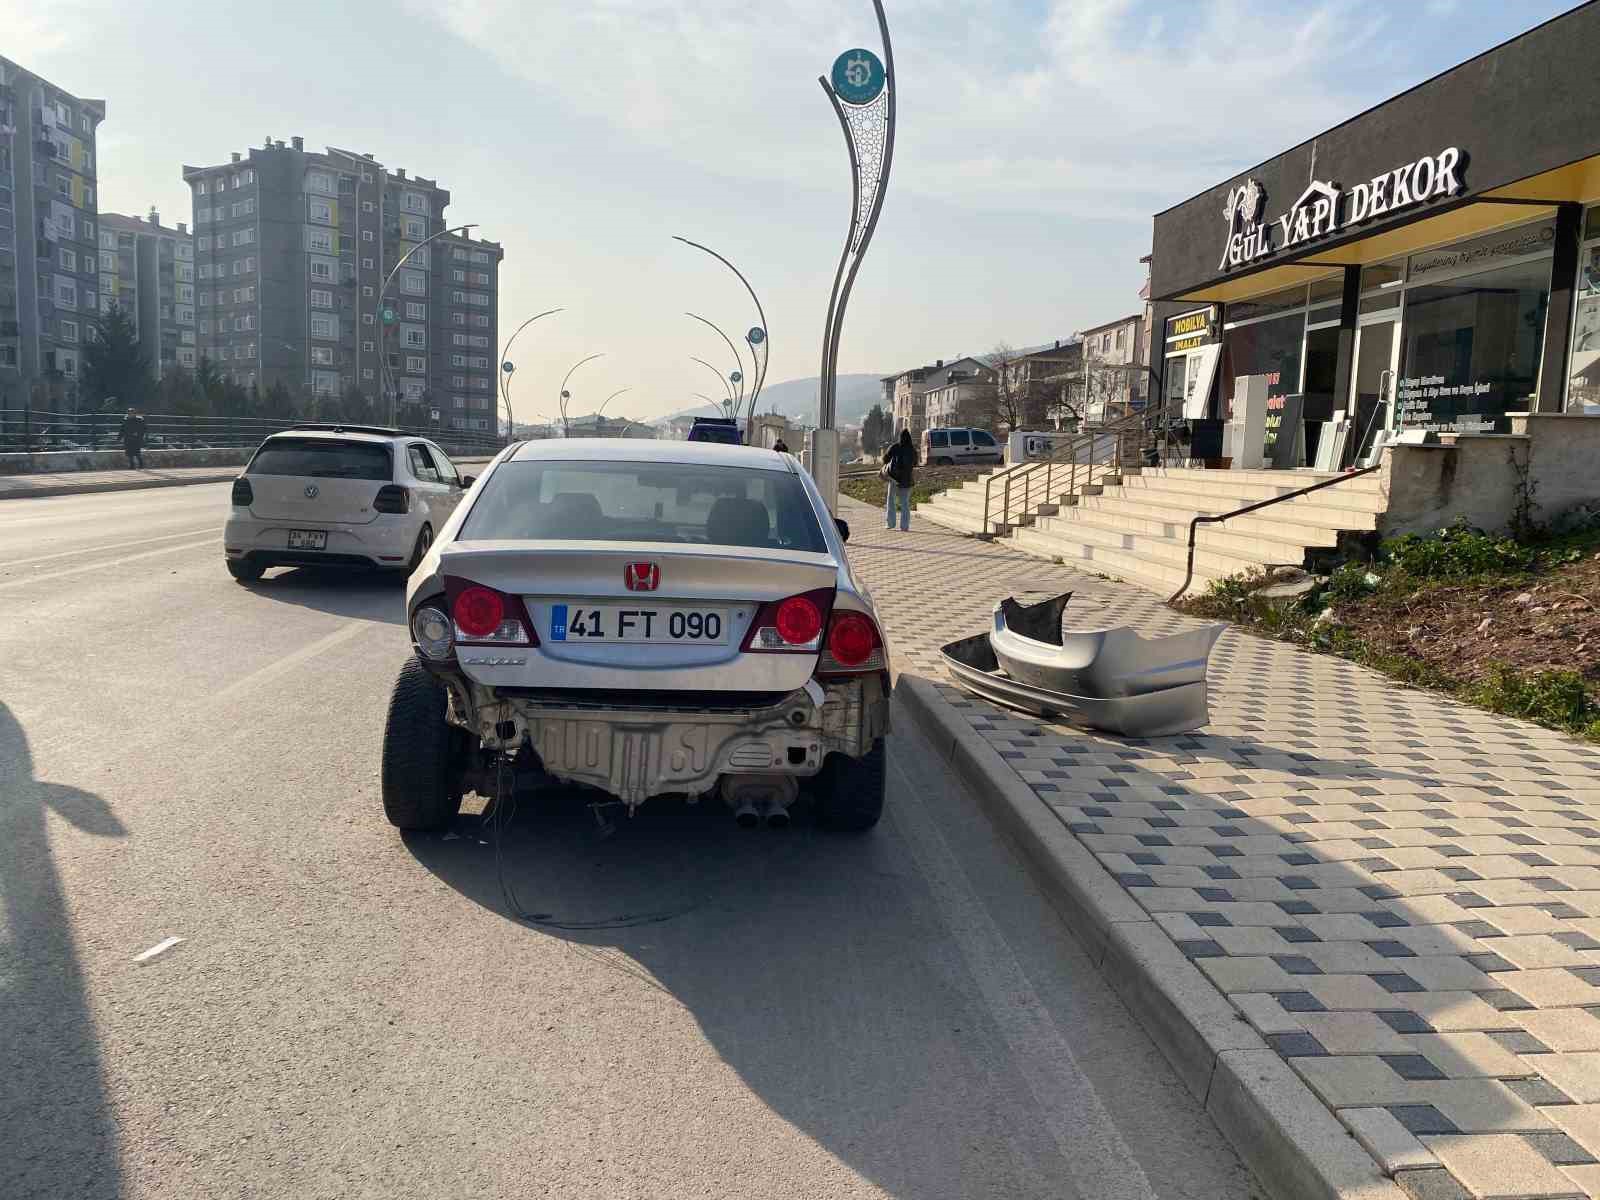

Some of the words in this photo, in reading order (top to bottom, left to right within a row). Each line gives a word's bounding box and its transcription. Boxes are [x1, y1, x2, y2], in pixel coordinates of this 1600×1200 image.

[1229, 221, 1269, 265] GÜL
[1279, 189, 1340, 248] YAPI
[1350, 147, 1460, 223] DEKOR
[569, 609, 604, 637] 41
[618, 611, 657, 637] FT
[669, 612, 721, 639] 090
